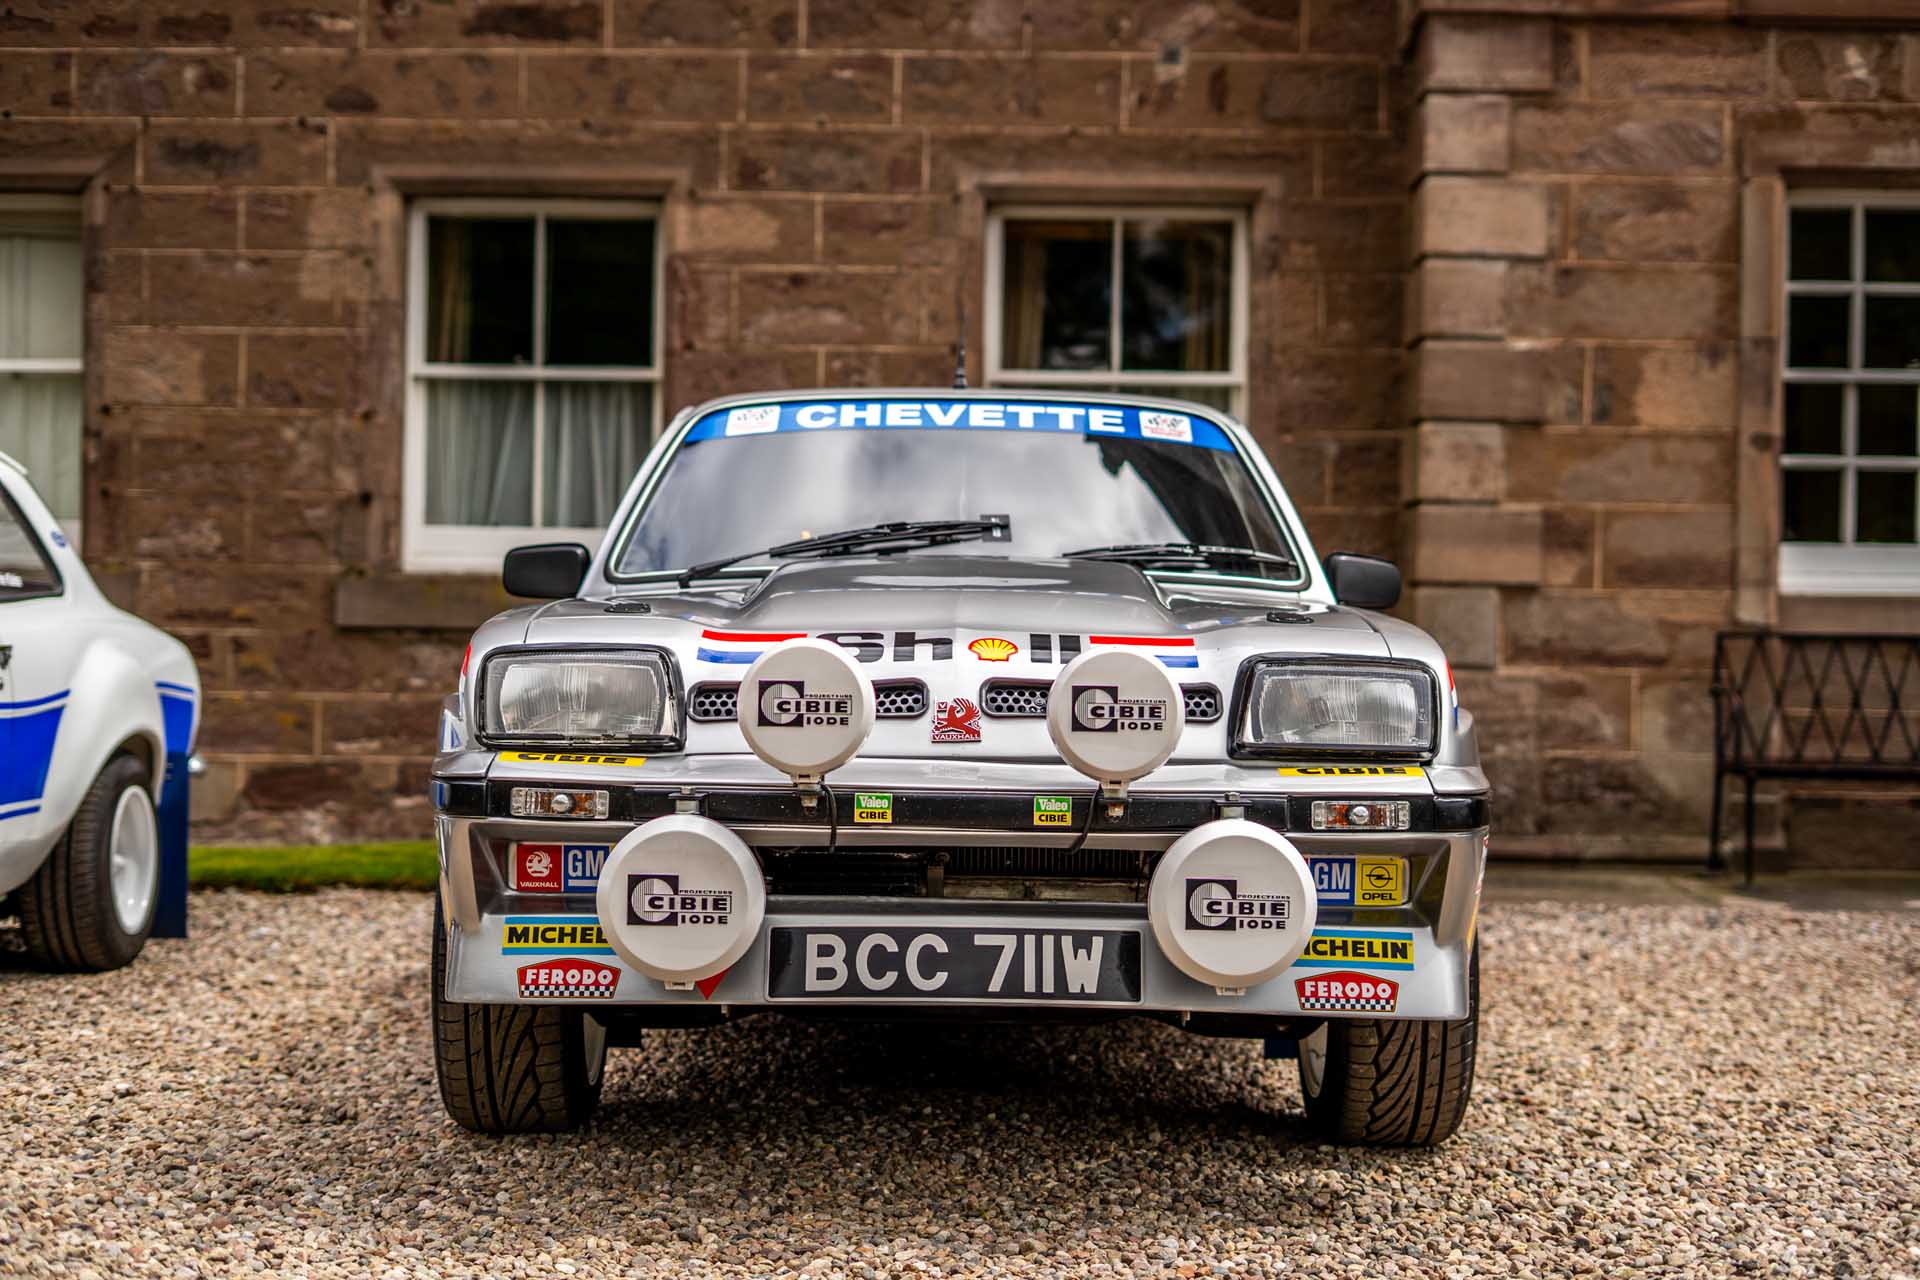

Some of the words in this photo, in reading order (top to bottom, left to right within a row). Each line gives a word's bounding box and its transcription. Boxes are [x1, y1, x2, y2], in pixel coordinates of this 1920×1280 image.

[796, 404, 1126, 433] CHEVETTE
[776, 700, 849, 713] CIBIE
[1089, 705, 1163, 719] CIBIE
[806, 716, 849, 726] IODE
[1120, 721, 1164, 731] IODE
[517, 753, 628, 764] CIBIE
[858, 795, 889, 808] Valeo
[1038, 798, 1068, 811] Valeo
[858, 811, 889, 820] CIBIE
[1038, 814, 1068, 822] CIBIE
[567, 849, 605, 878] GM
[1314, 862, 1350, 891] GM
[1361, 892, 1397, 901] OPEL
[647, 896, 728, 912] CIBIE
[1206, 900, 1286, 916] CIBIE
[680, 914, 729, 925] IODE
[1239, 919, 1287, 930] IODE
[507, 926, 609, 944] MICHEL
[1303, 939, 1409, 960] ICHELIN
[805, 932, 949, 992] BCC
[974, 934, 1104, 994] 711W
[525, 968, 614, 985] FERODO
[1304, 980, 1392, 998] FERODO
